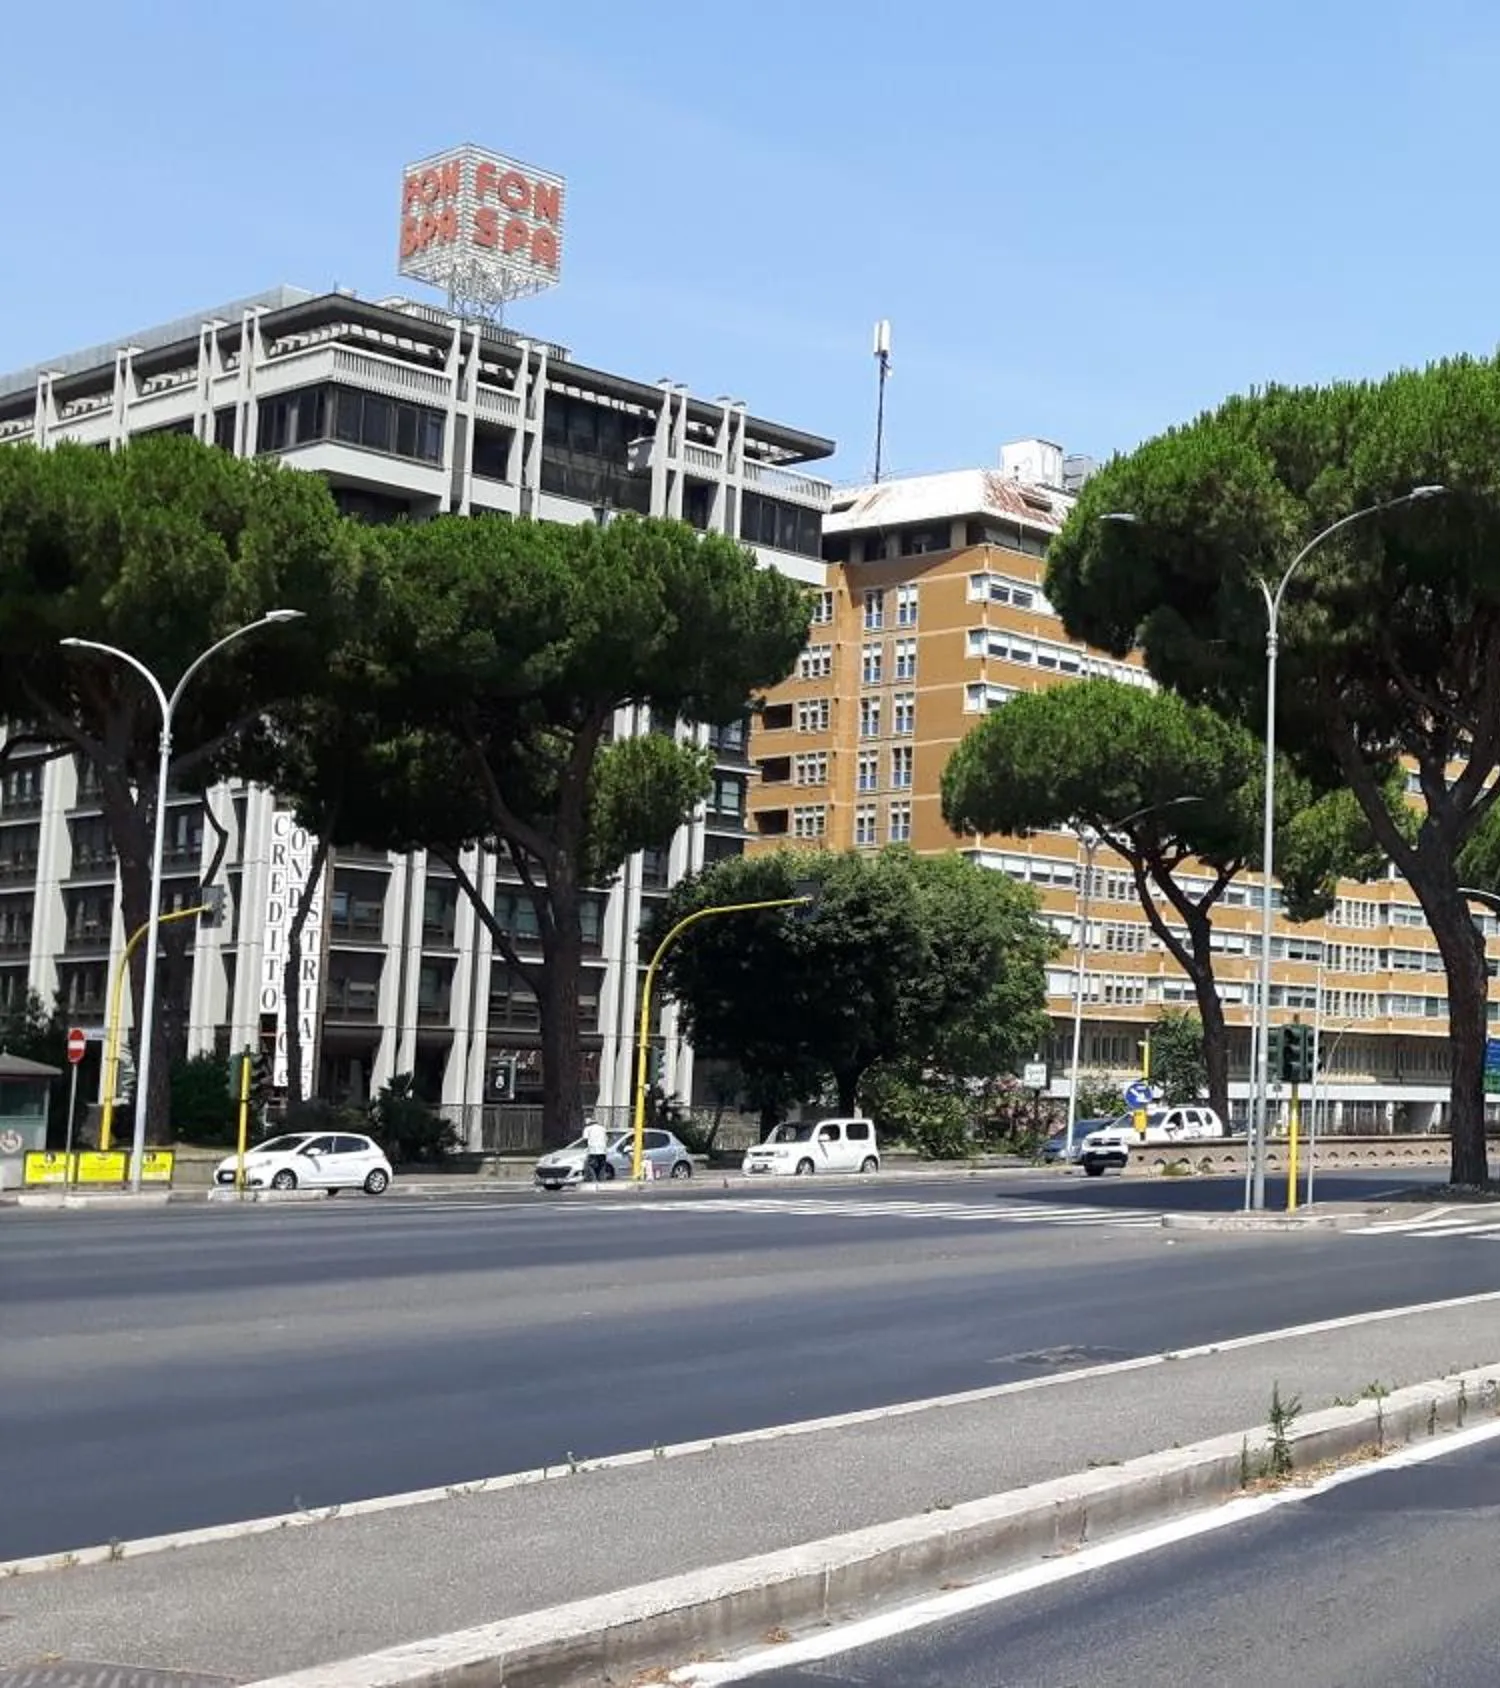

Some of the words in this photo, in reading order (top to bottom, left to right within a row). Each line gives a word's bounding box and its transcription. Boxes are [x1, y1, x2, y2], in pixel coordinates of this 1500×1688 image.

[476, 162, 560, 225] FON
[474, 207, 557, 268] SPA
[261, 815, 288, 1010] CREDITO
